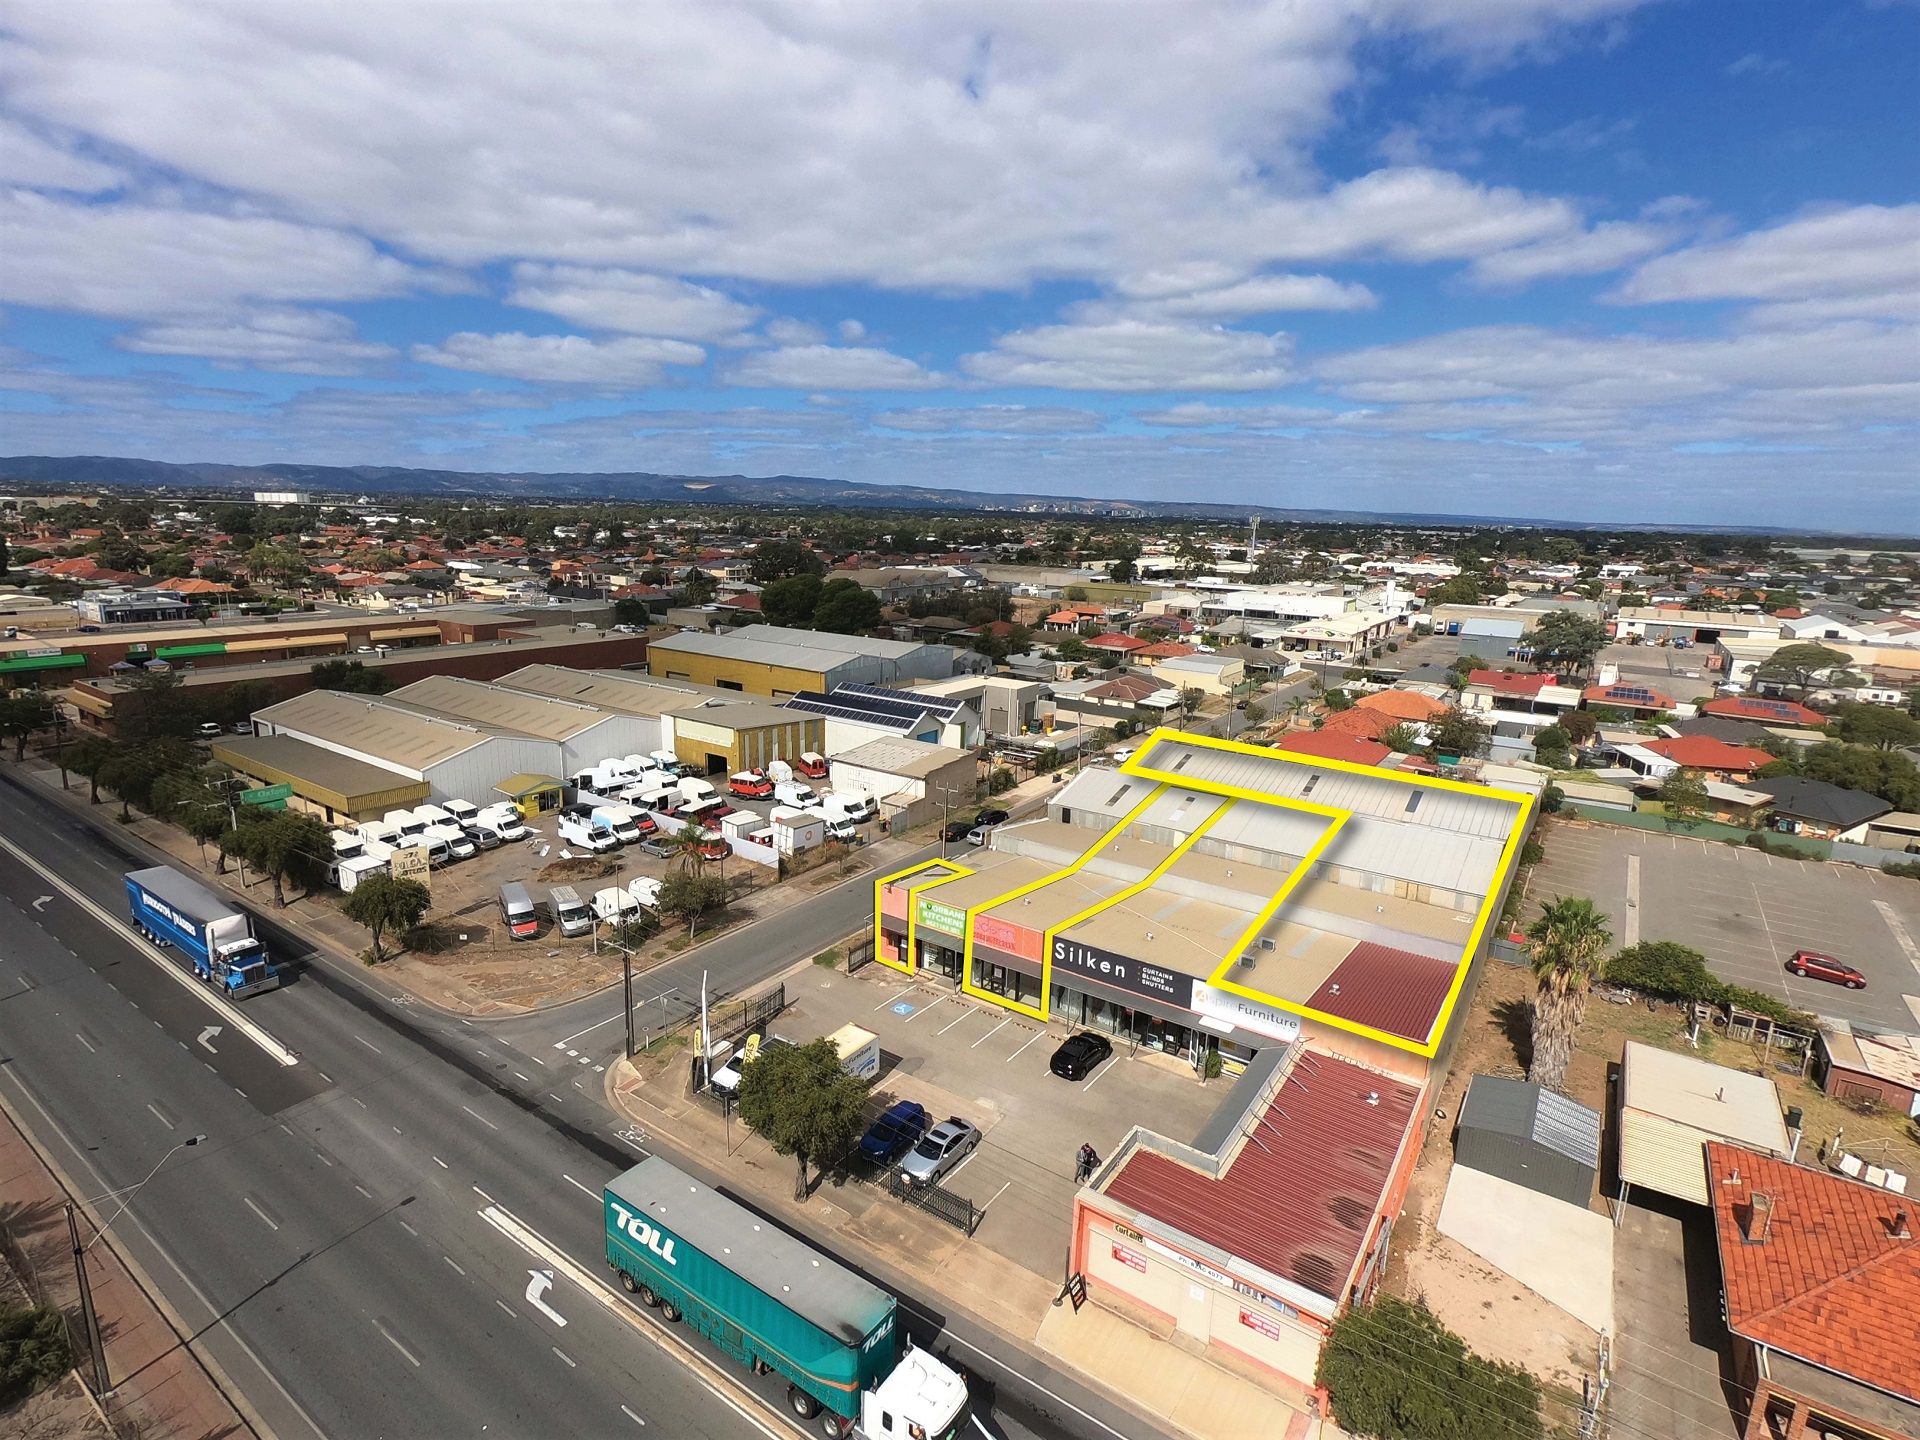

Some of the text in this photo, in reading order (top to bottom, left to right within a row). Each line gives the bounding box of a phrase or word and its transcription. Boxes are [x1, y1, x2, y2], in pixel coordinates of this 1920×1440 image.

[923, 910, 963, 929] KITCHENS
[1054, 942, 1126, 978] Silken
[1141, 973, 1165, 984] BLINDS
[1142, 967, 1173, 981] CURTAINS
[1141, 979, 1174, 994] SHUTTERS
[1238, 1003, 1298, 1029] Furniture
[610, 1202, 677, 1266] TOLL
[862, 1315, 894, 1354] TOLL
